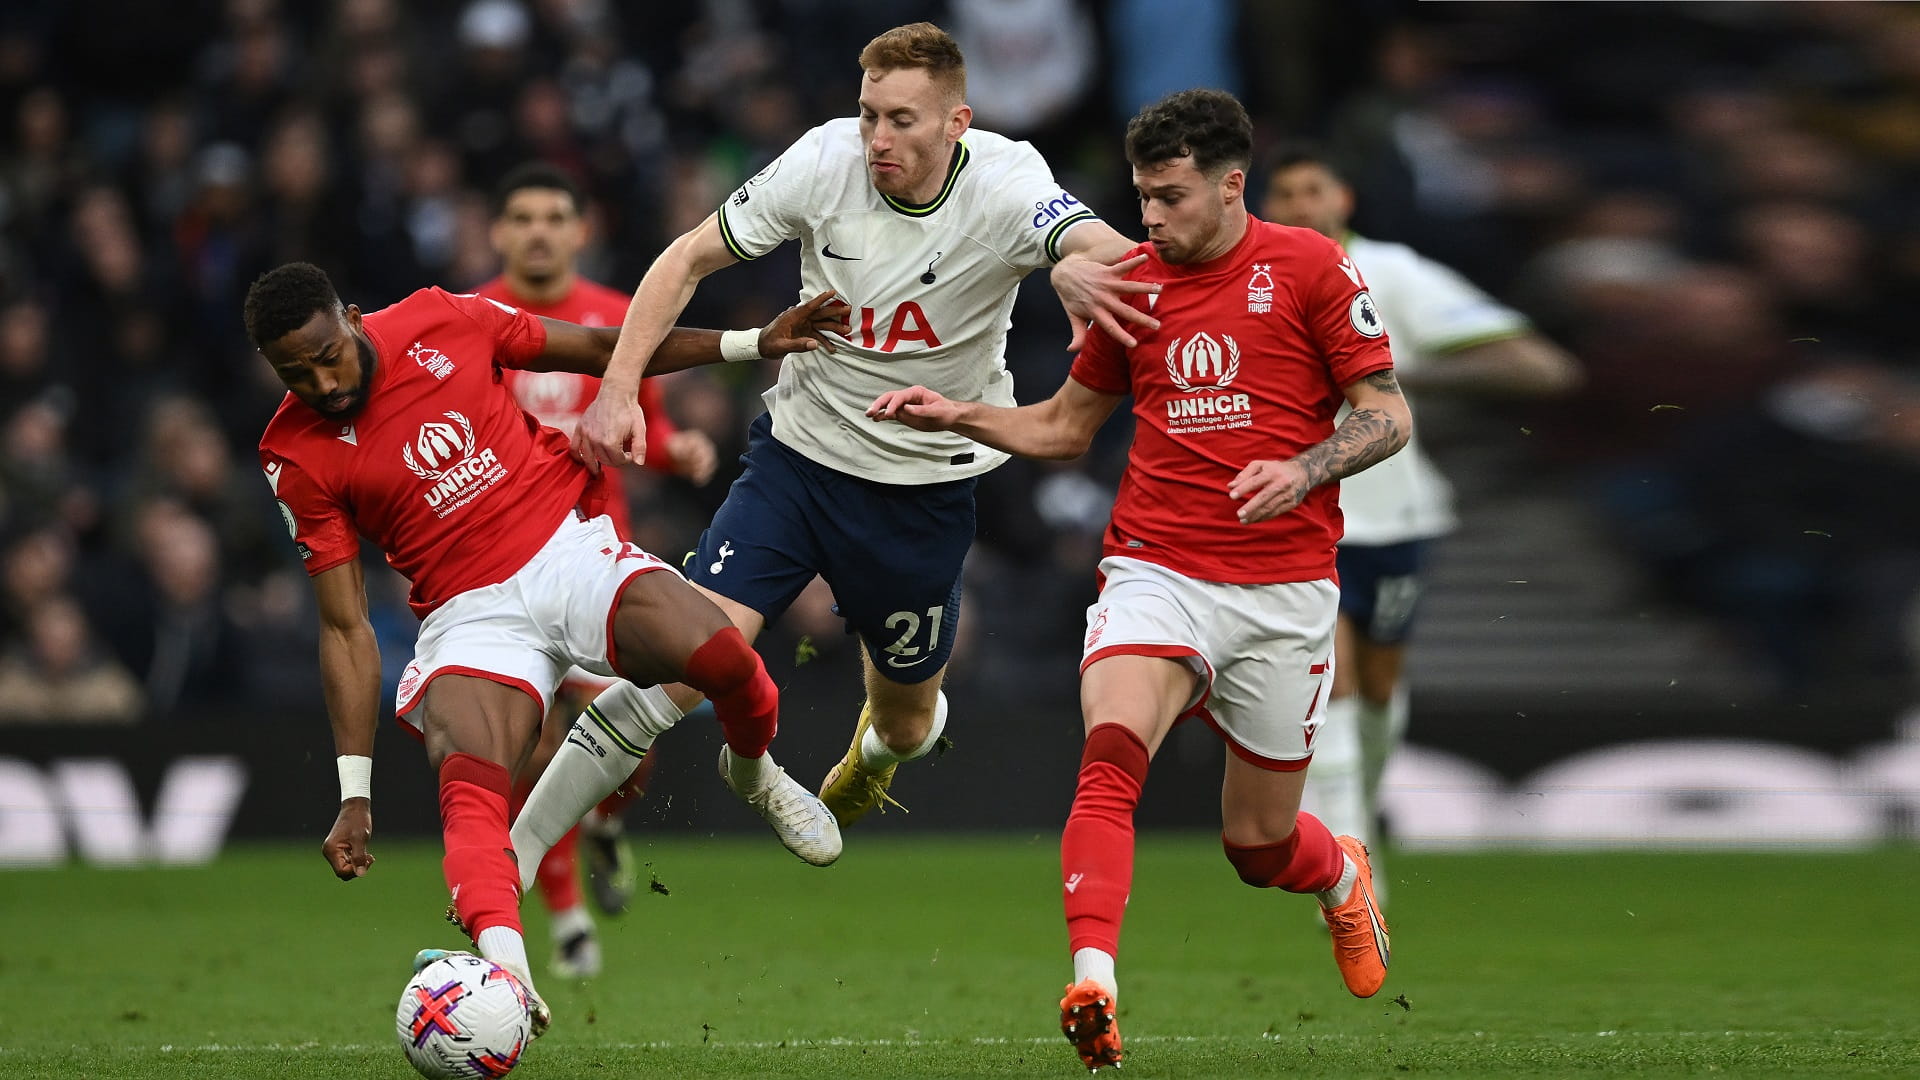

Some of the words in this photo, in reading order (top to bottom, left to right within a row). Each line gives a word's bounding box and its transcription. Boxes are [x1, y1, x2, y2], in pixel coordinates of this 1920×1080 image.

[826, 299, 942, 352] IA
[1167, 394, 1250, 418] UNHCR
[1187, 426, 1216, 434] Kingdom
[1227, 420, 1252, 429] UNHCR
[1191, 416, 1222, 424] Refugee
[1224, 413, 1251, 421] Agency
[424, 448, 497, 507] UNHCR
[438, 506, 457, 519] United
[456, 490, 481, 508] Kingdom
[480, 483, 489, 492] for
[488, 469, 508, 486] UNHCR
[446, 495, 457, 505] UN
[456, 479, 483, 499] Refugee
[482, 463, 503, 481] Agency
[883, 605, 943, 656] 21
[572, 722, 607, 758] SPURS
